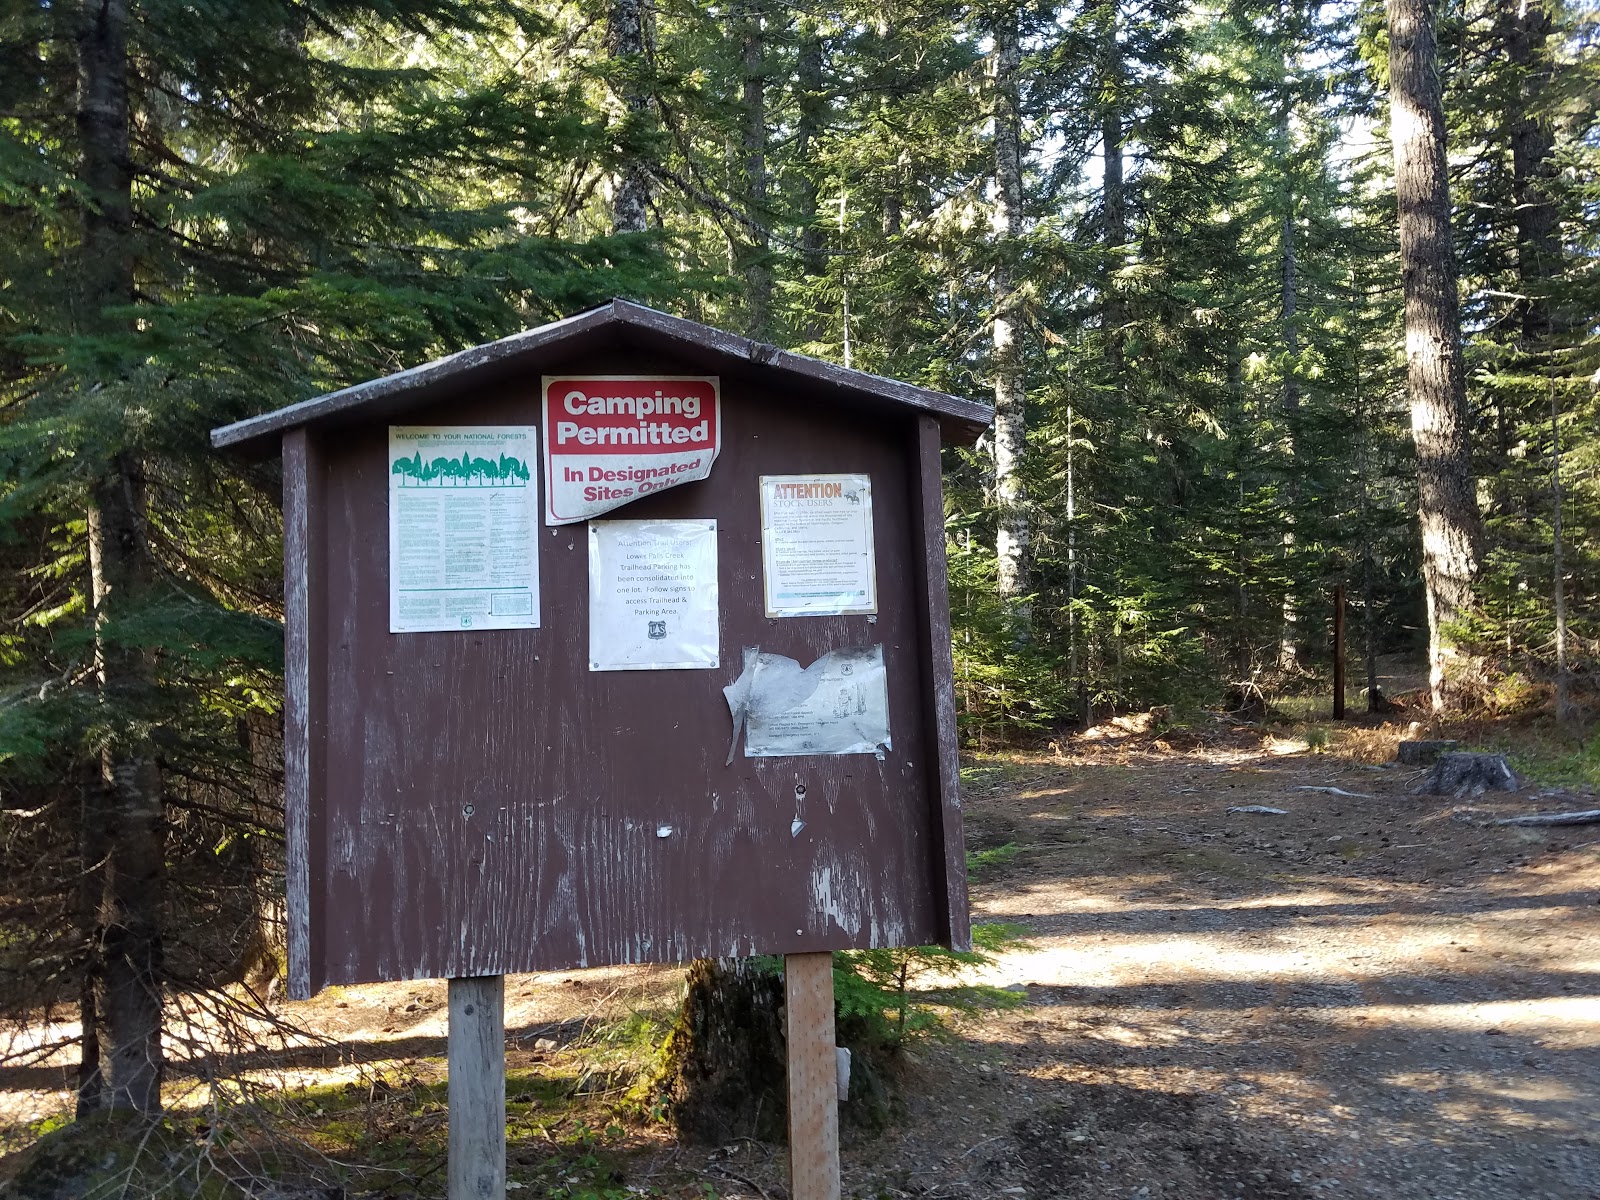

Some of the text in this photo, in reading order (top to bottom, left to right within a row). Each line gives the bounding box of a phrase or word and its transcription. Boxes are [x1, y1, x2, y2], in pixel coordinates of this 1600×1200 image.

[563, 390, 701, 420] Camping
[557, 419, 709, 445] Permitted
[564, 458, 701, 483] In Designated
[583, 486, 634, 502] Sites
[773, 482, 842, 499] ATTENTION
[773, 499, 833, 508] STOCK USERS
[618, 539, 652, 547] Attention
[653, 562, 678, 570] Parking
[636, 574, 679, 582] consolidated
[670, 585, 686, 593] signs
[648, 596, 680, 604] Trailhead
[634, 608, 660, 616] Parking
